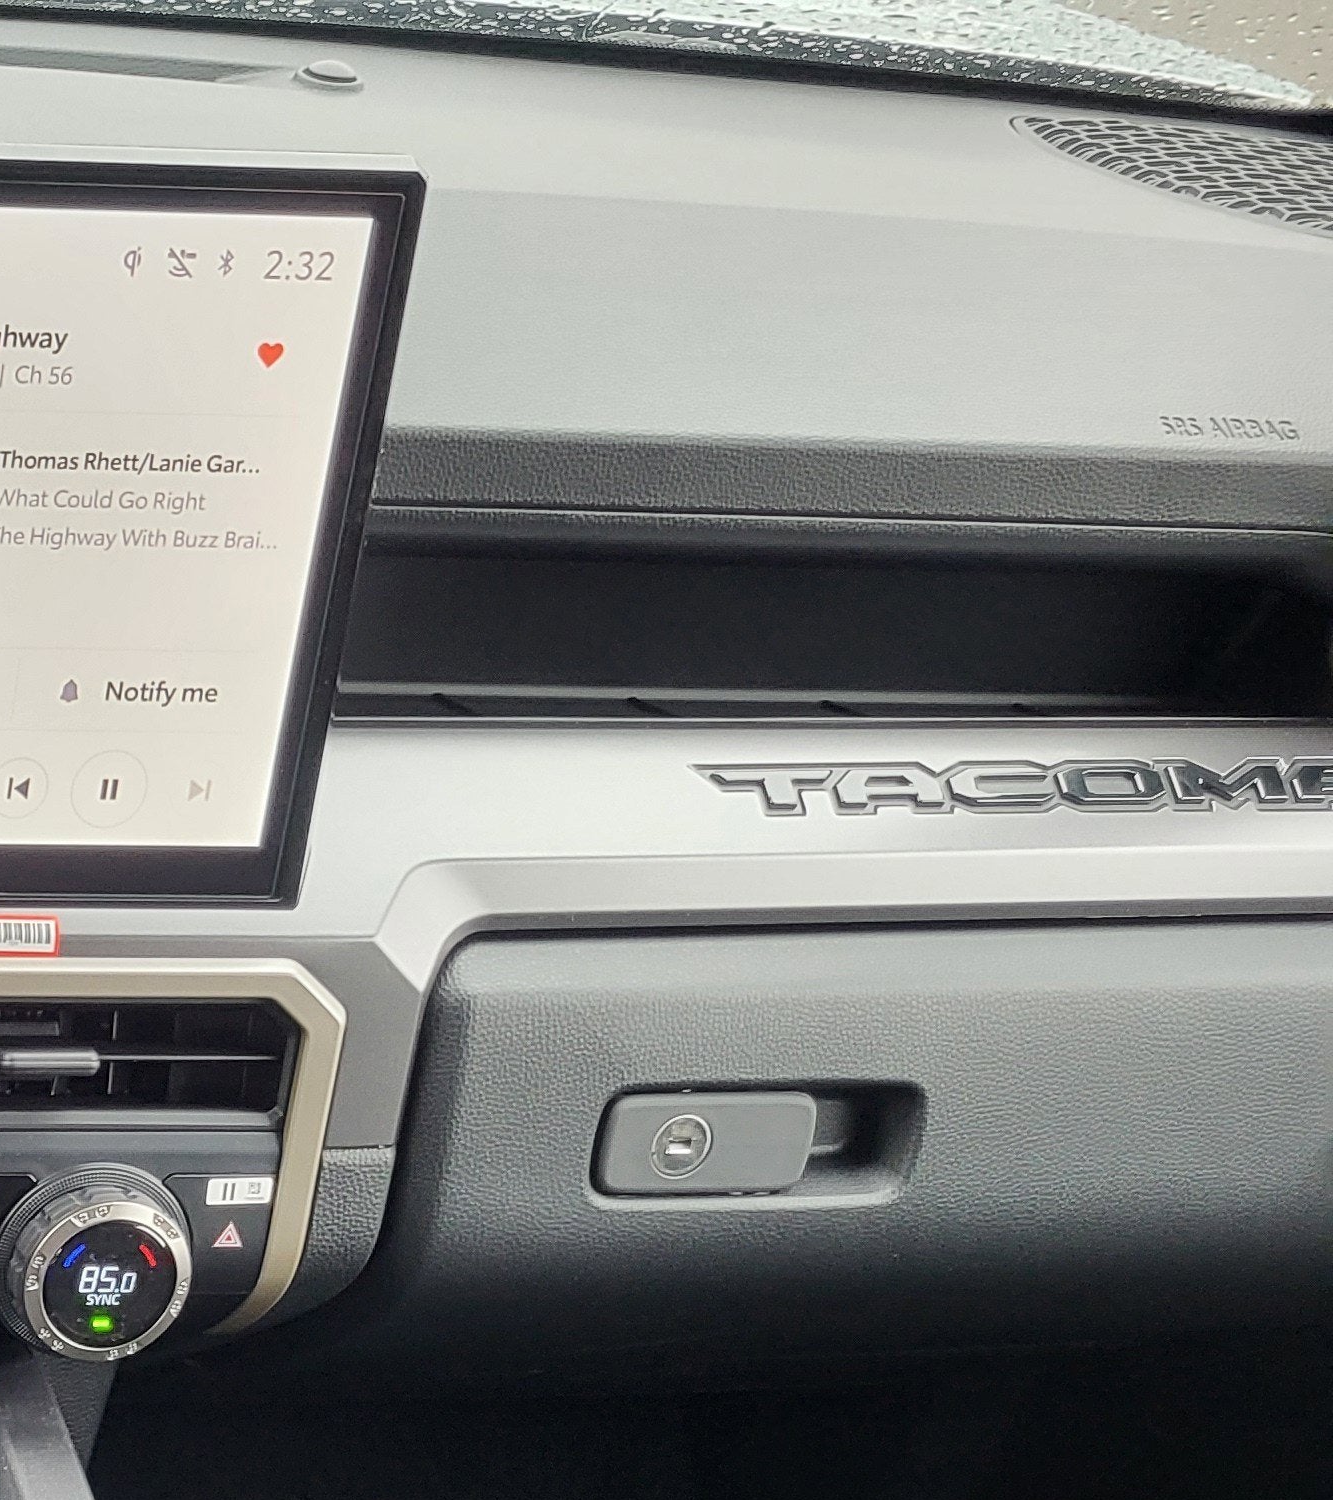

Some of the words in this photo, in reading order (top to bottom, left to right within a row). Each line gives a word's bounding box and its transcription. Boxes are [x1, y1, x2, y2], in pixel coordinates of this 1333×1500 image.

[264, 250, 334, 282] 2:32
[15, 365, 42, 385] Ch
[48, 366, 74, 385] 56
[1159, 415, 1204, 439] SRS
[1210, 416, 1301, 442] AIRBAG
[0, 450, 78, 471] Thomas
[84, 452, 202, 475] Rhett/Lanie
[53, 489, 113, 509] Could
[118, 491, 148, 510] Go
[153, 491, 206, 515] Right
[30, 527, 117, 551] Highway
[122, 529, 167, 548] With
[174, 530, 218, 549] Buzz
[106, 681, 176, 707] Notify
[182, 685, 218, 704] me
[79, 1266, 137, 1294] 85.0
[85, 1293, 121, 1306] SYNC
